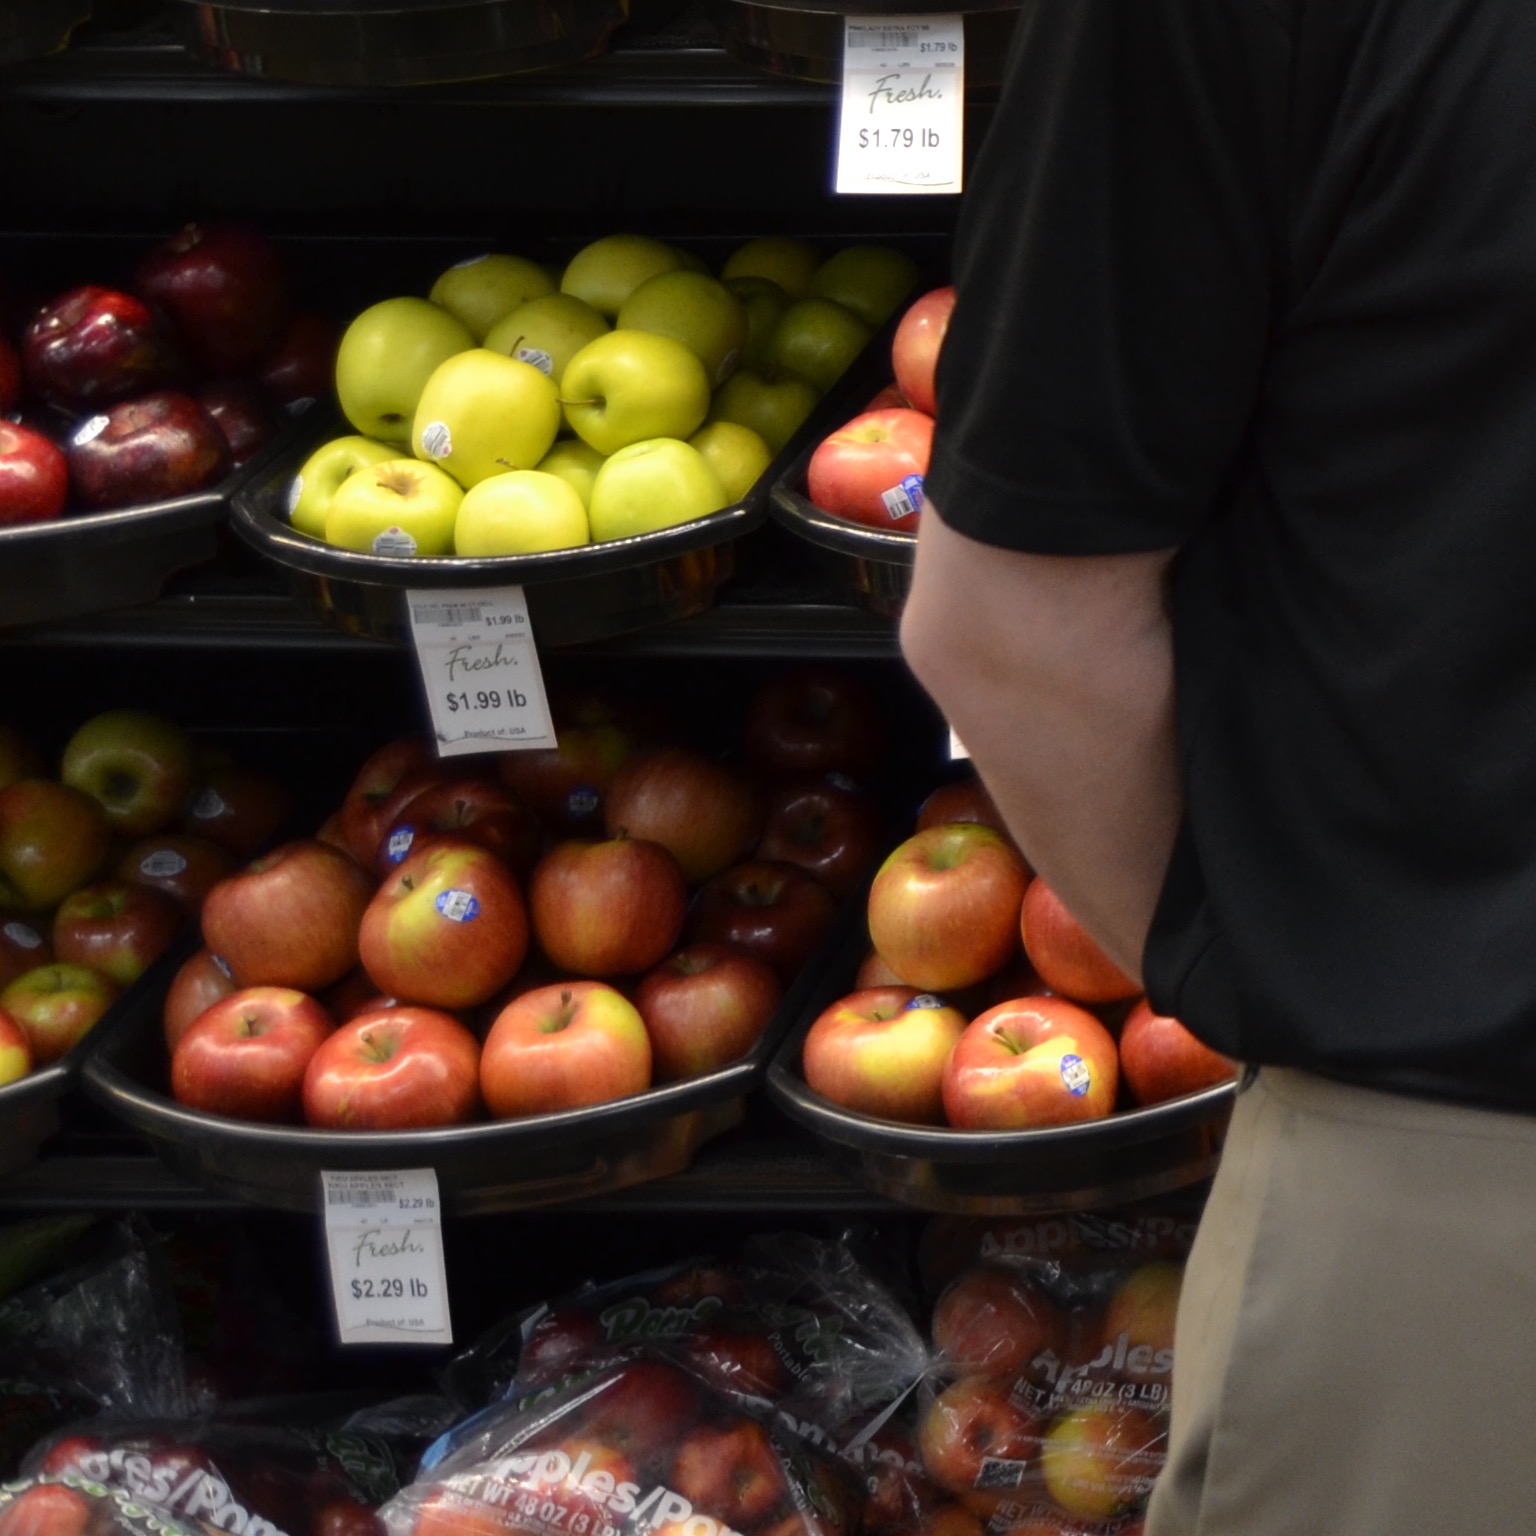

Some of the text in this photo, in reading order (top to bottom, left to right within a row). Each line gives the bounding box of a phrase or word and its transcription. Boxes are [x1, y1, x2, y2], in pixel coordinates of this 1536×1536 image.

[919, 42, 946, 54] $1.79
[858, 128, 940, 148] $1.79 lb
[485, 615, 512, 627] $1.99
[446, 689, 527, 713] $1.99 lb
[509, 727, 526, 735] USA
[398, 1198, 423, 1209] $2.29
[350, 1278, 428, 1300] $2.29 lb
[482, 1482, 514, 1508] WT
[514, 1493, 538, 1515] 48
[539, 1499, 569, 1525] OZ
